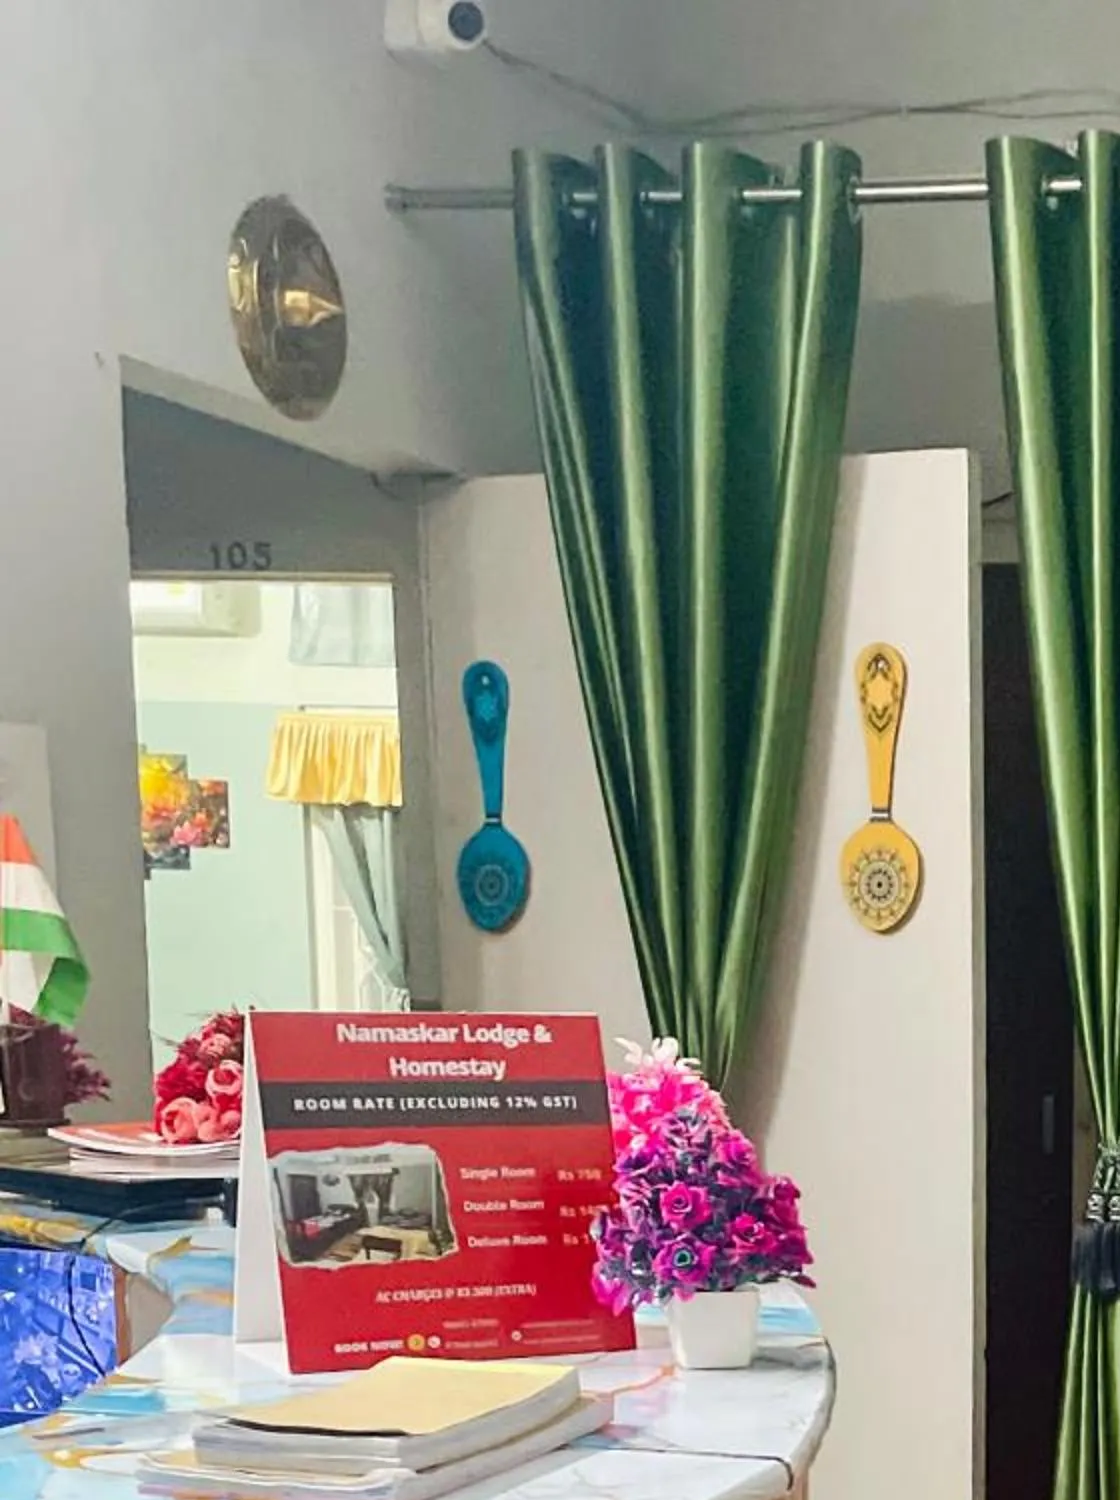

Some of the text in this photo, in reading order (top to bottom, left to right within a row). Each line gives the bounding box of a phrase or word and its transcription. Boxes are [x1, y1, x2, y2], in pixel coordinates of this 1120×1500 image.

[209, 541, 272, 571] 105
[336, 1023, 552, 1048] Namaskar Lodge &
[389, 1056, 507, 1081] Homestay
[294, 1095, 578, 1111] ROOM RATE (EXCLUDING 12% GST)
[459, 1167, 498, 1181] Single
[501, 1166, 536, 1178] Room
[463, 1200, 508, 1213] Double
[509, 1199, 545, 1210] Room
[467, 1236, 511, 1248] Deluxe
[512, 1234, 548, 1245] Room
